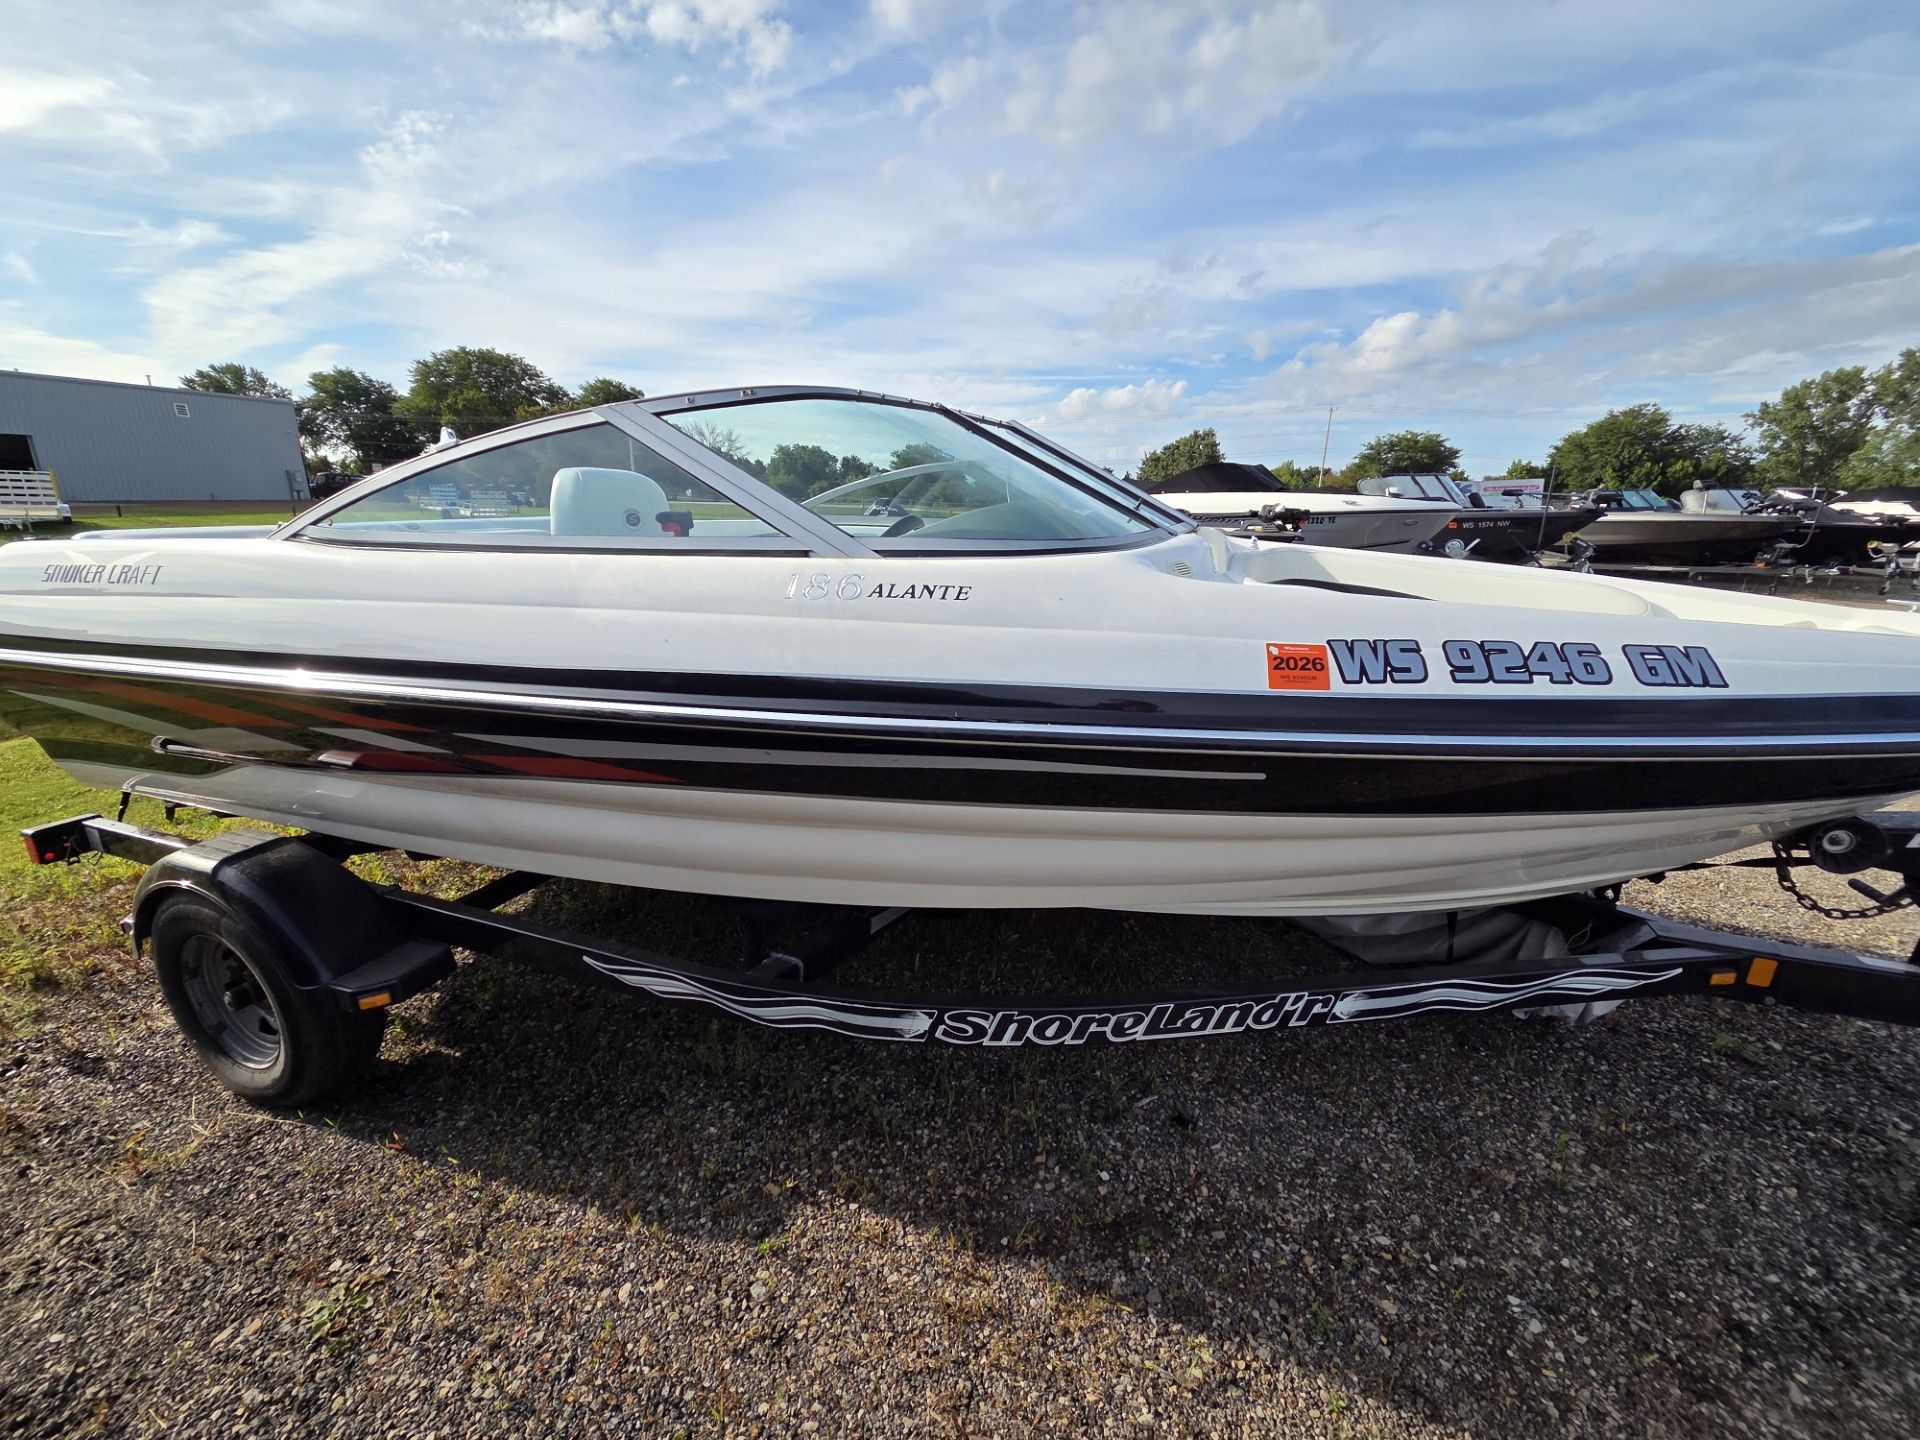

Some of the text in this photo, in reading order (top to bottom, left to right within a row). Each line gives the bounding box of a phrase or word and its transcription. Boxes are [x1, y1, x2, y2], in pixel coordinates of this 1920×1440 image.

[41, 564, 164, 585] SMOKER CRAFT
[784, 572, 972, 600] 186 ALANTE
[1272, 656, 1325, 672] 2026
[1326, 638, 1729, 688] WS 9246 GM
[937, 992, 1335, 1046] ShoreLand'r
